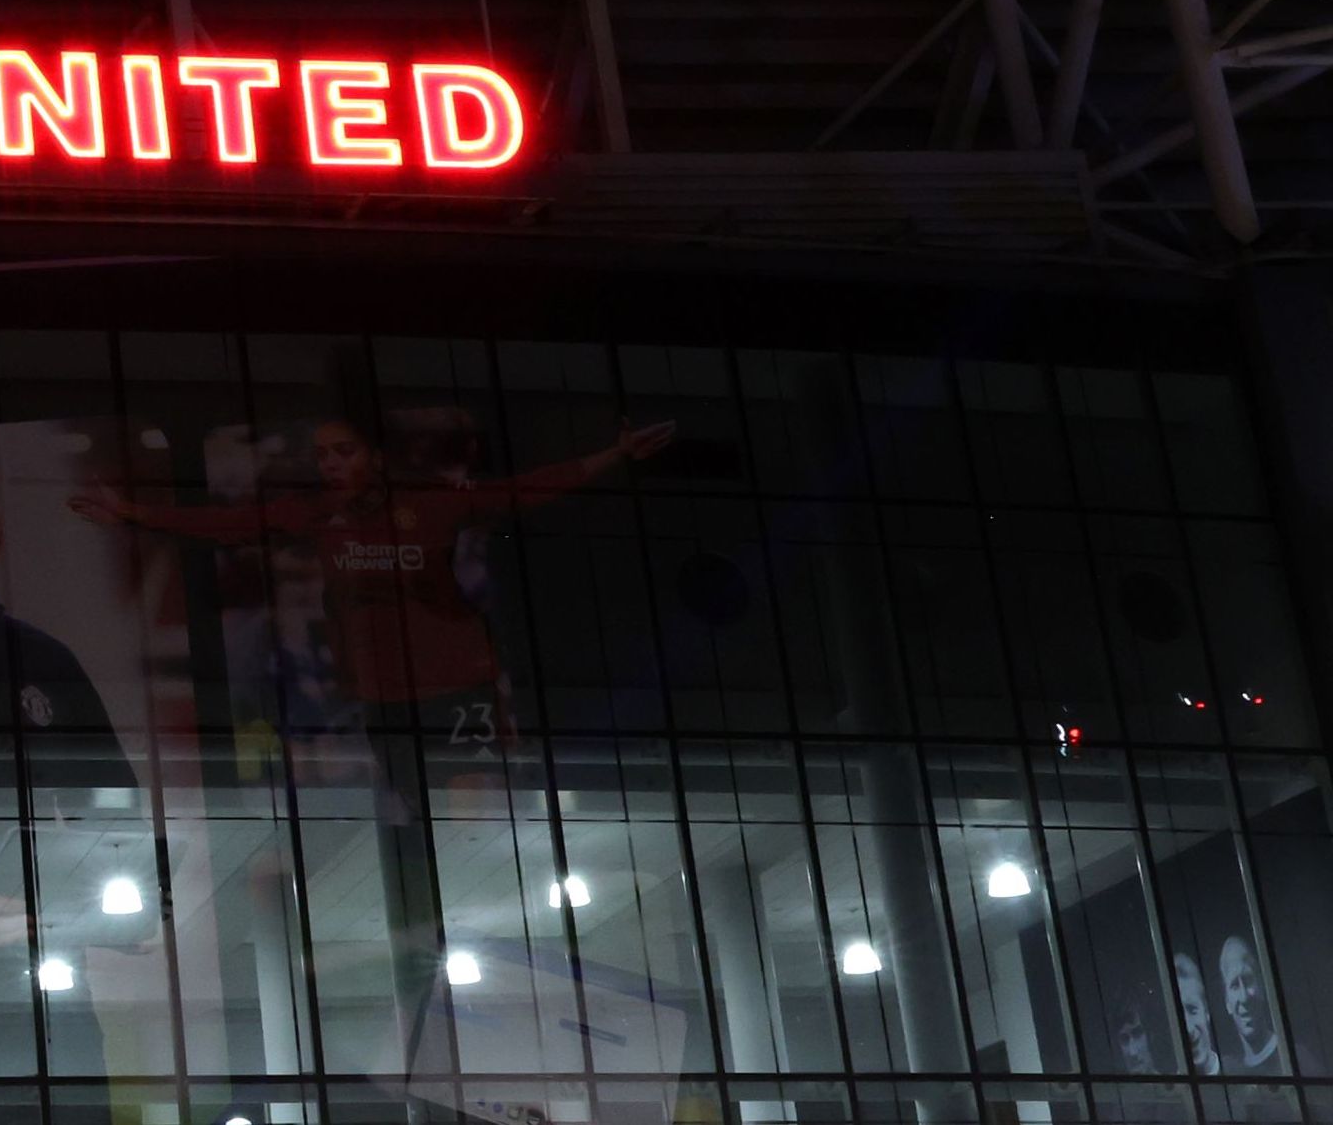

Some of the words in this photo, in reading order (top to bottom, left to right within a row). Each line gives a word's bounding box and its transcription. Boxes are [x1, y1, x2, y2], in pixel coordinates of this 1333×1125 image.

[343, 541, 397, 557] Team
[333, 554, 397, 570] Viewer
[449, 703, 496, 745] 23
